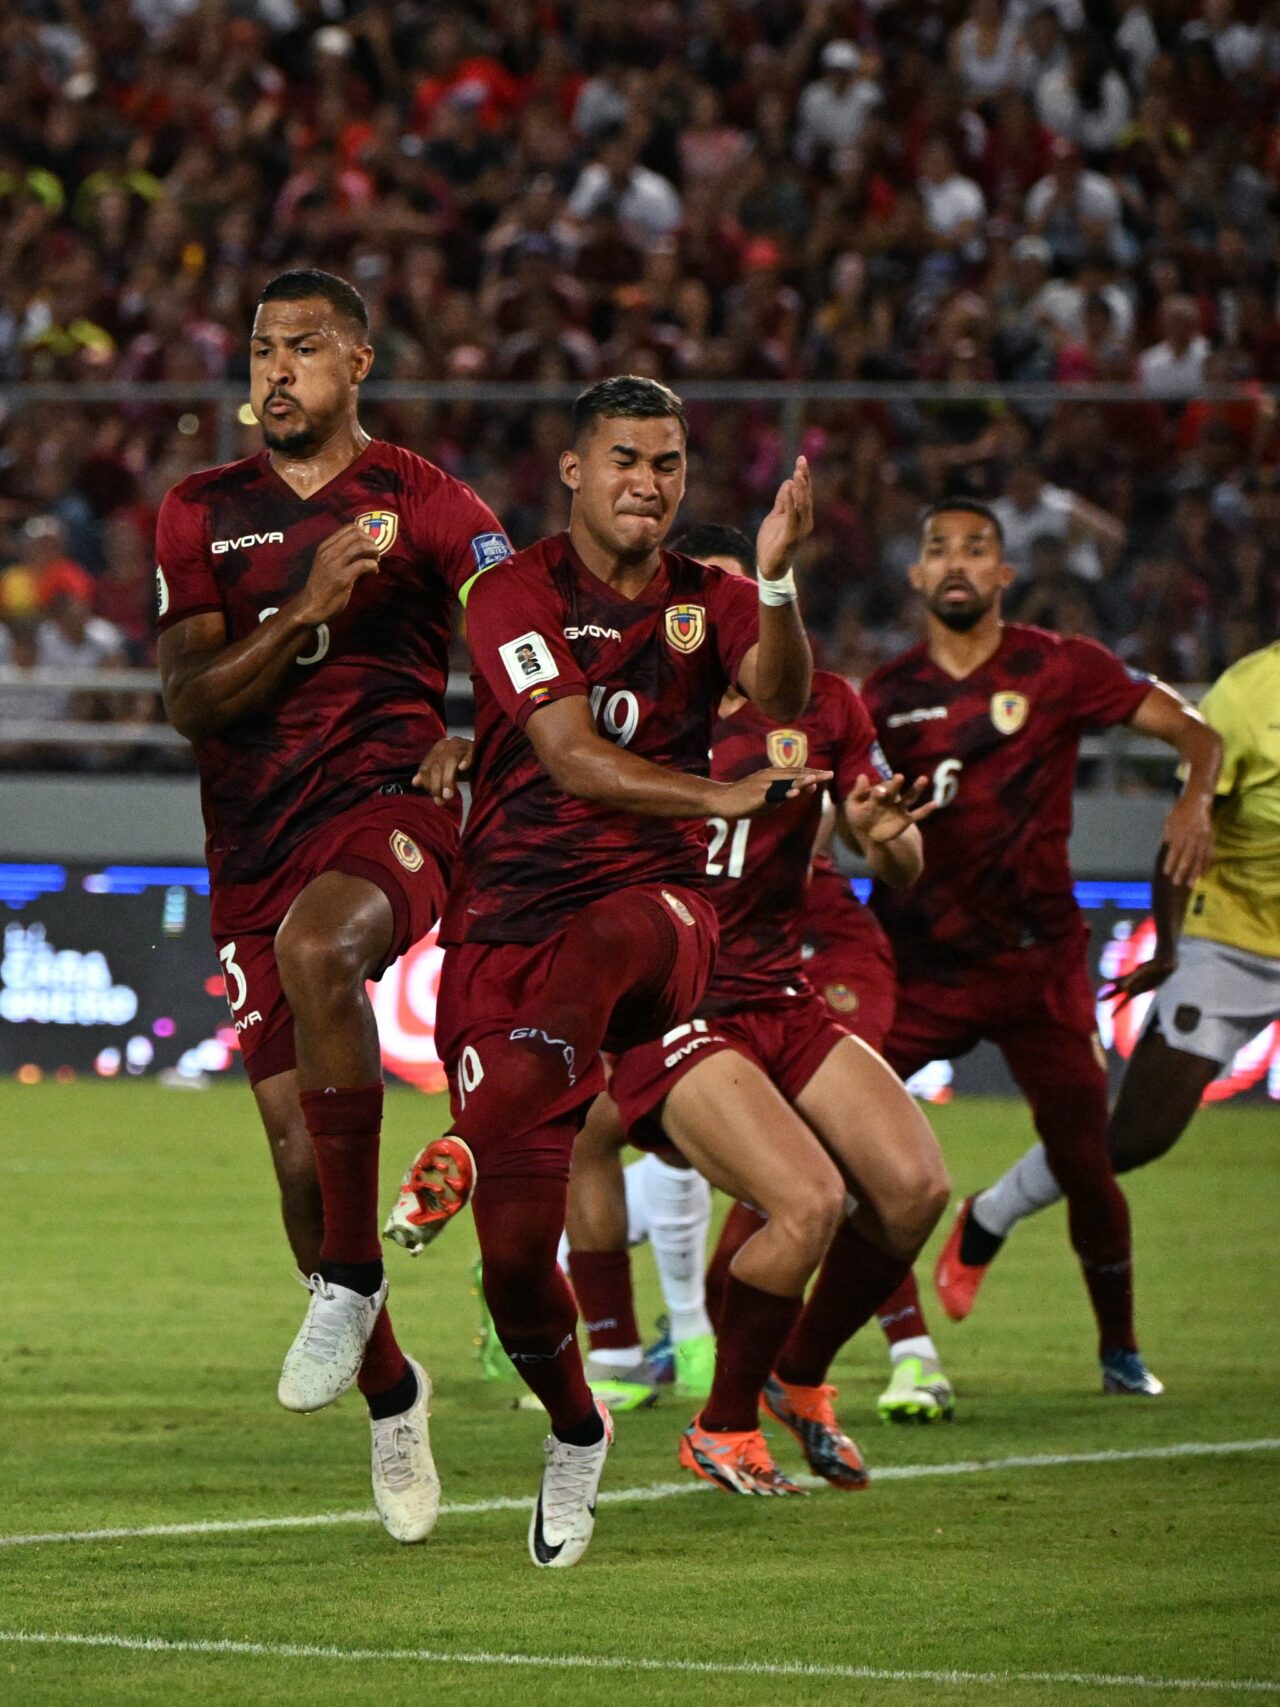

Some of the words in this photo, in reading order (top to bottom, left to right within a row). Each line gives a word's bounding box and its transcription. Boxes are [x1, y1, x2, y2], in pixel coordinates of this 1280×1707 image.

[211, 532, 284, 554] GIVOVA
[563, 624, 622, 643] GVOVA
[933, 759, 963, 809] 6
[705, 817, 751, 879] 21
[220, 941, 247, 1018] 3
[234, 1010, 263, 1034] OVA
